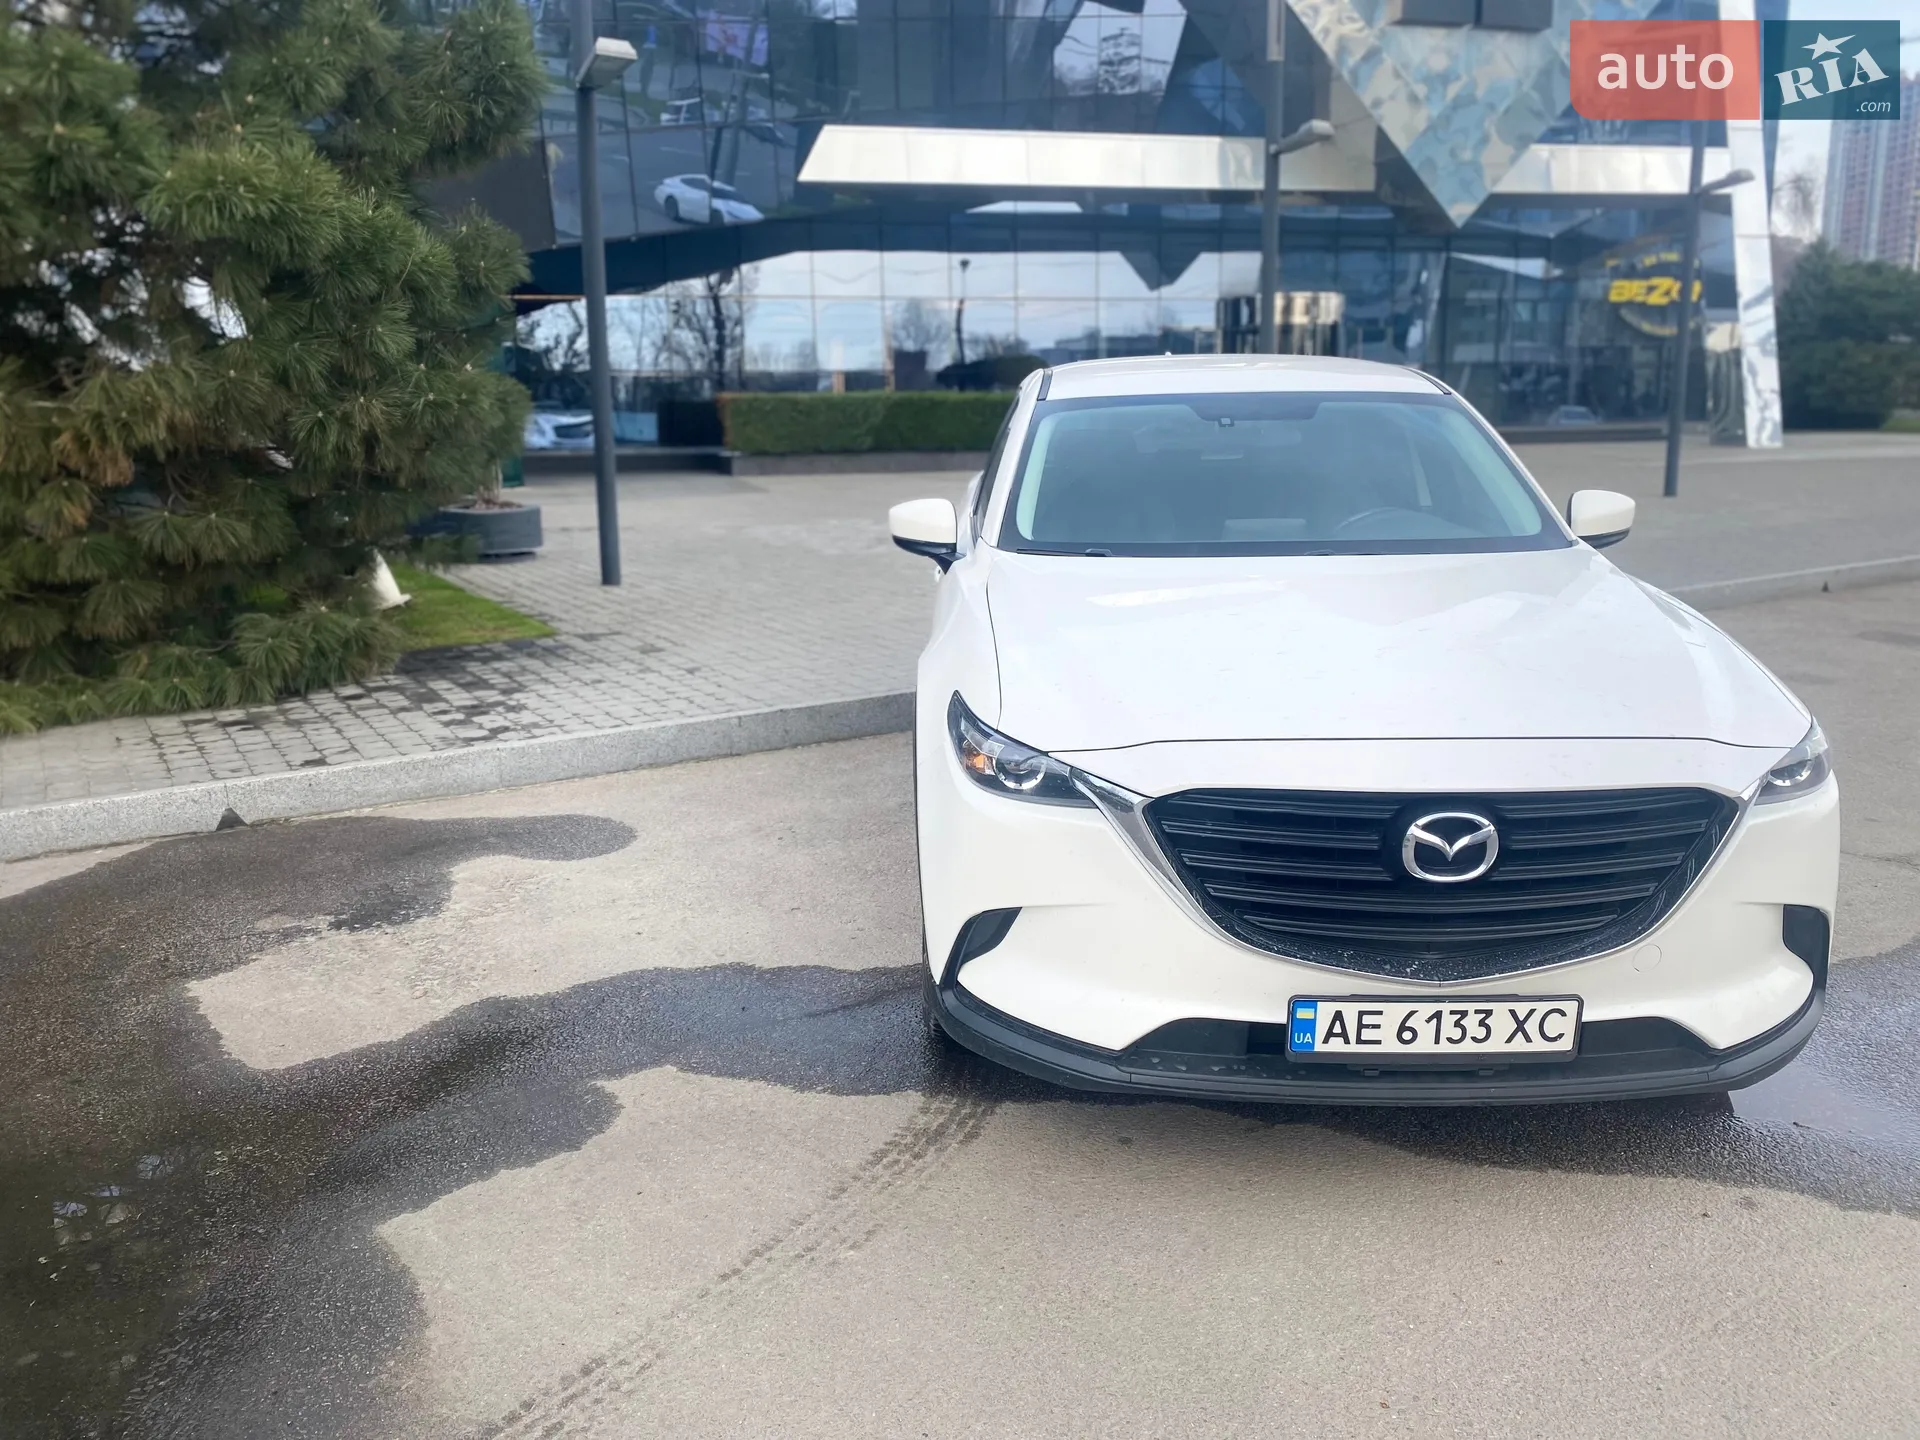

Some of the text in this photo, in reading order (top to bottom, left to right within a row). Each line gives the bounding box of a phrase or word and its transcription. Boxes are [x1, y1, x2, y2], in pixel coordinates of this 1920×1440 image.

[1294, 1032, 1313, 1044] UA
[1321, 1007, 1568, 1045] AE 6133 XC
